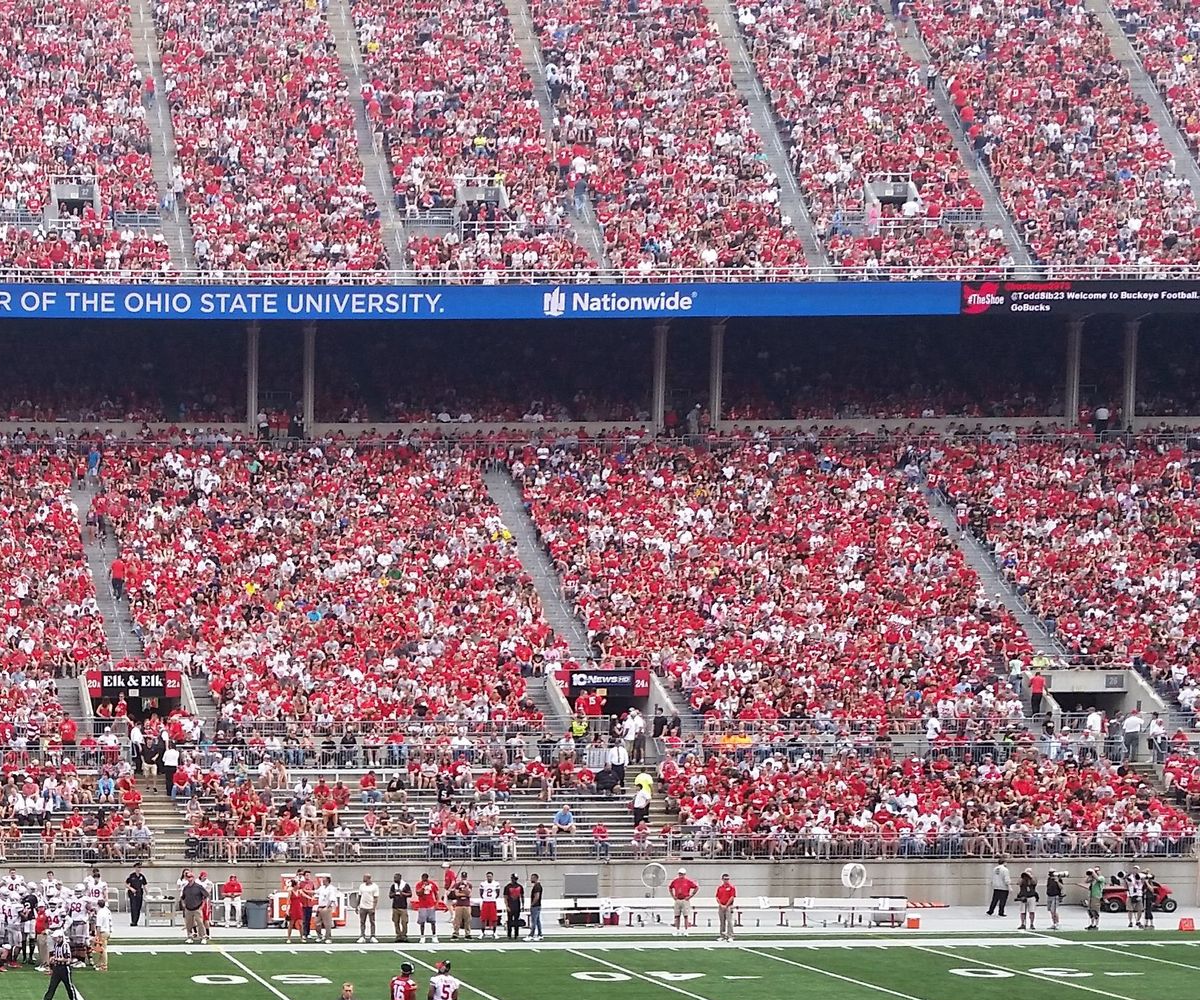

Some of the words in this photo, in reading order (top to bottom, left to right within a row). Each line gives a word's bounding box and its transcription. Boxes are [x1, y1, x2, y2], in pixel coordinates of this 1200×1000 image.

[967, 293, 1004, 305] #TheShoe
[1066, 291, 1107, 300] Welcome
[1109, 291, 1118, 300] to
[1120, 291, 1159, 301] Buckeye
[1161, 291, 1200, 300] Football.
[20, 292, 56, 312] OF
[65, 292, 115, 312] THE
[124, 292, 191, 314] OHIO
[200, 293, 278, 314] STATE
[287, 293, 444, 314] UNIVERSITY.
[1011, 303, 1050, 312] GoBucks
[103, 674, 125, 687] Elk
[127, 674, 139, 687] &
[141, 674, 164, 687] Elk
[441, 984, 450, 1000] 5
